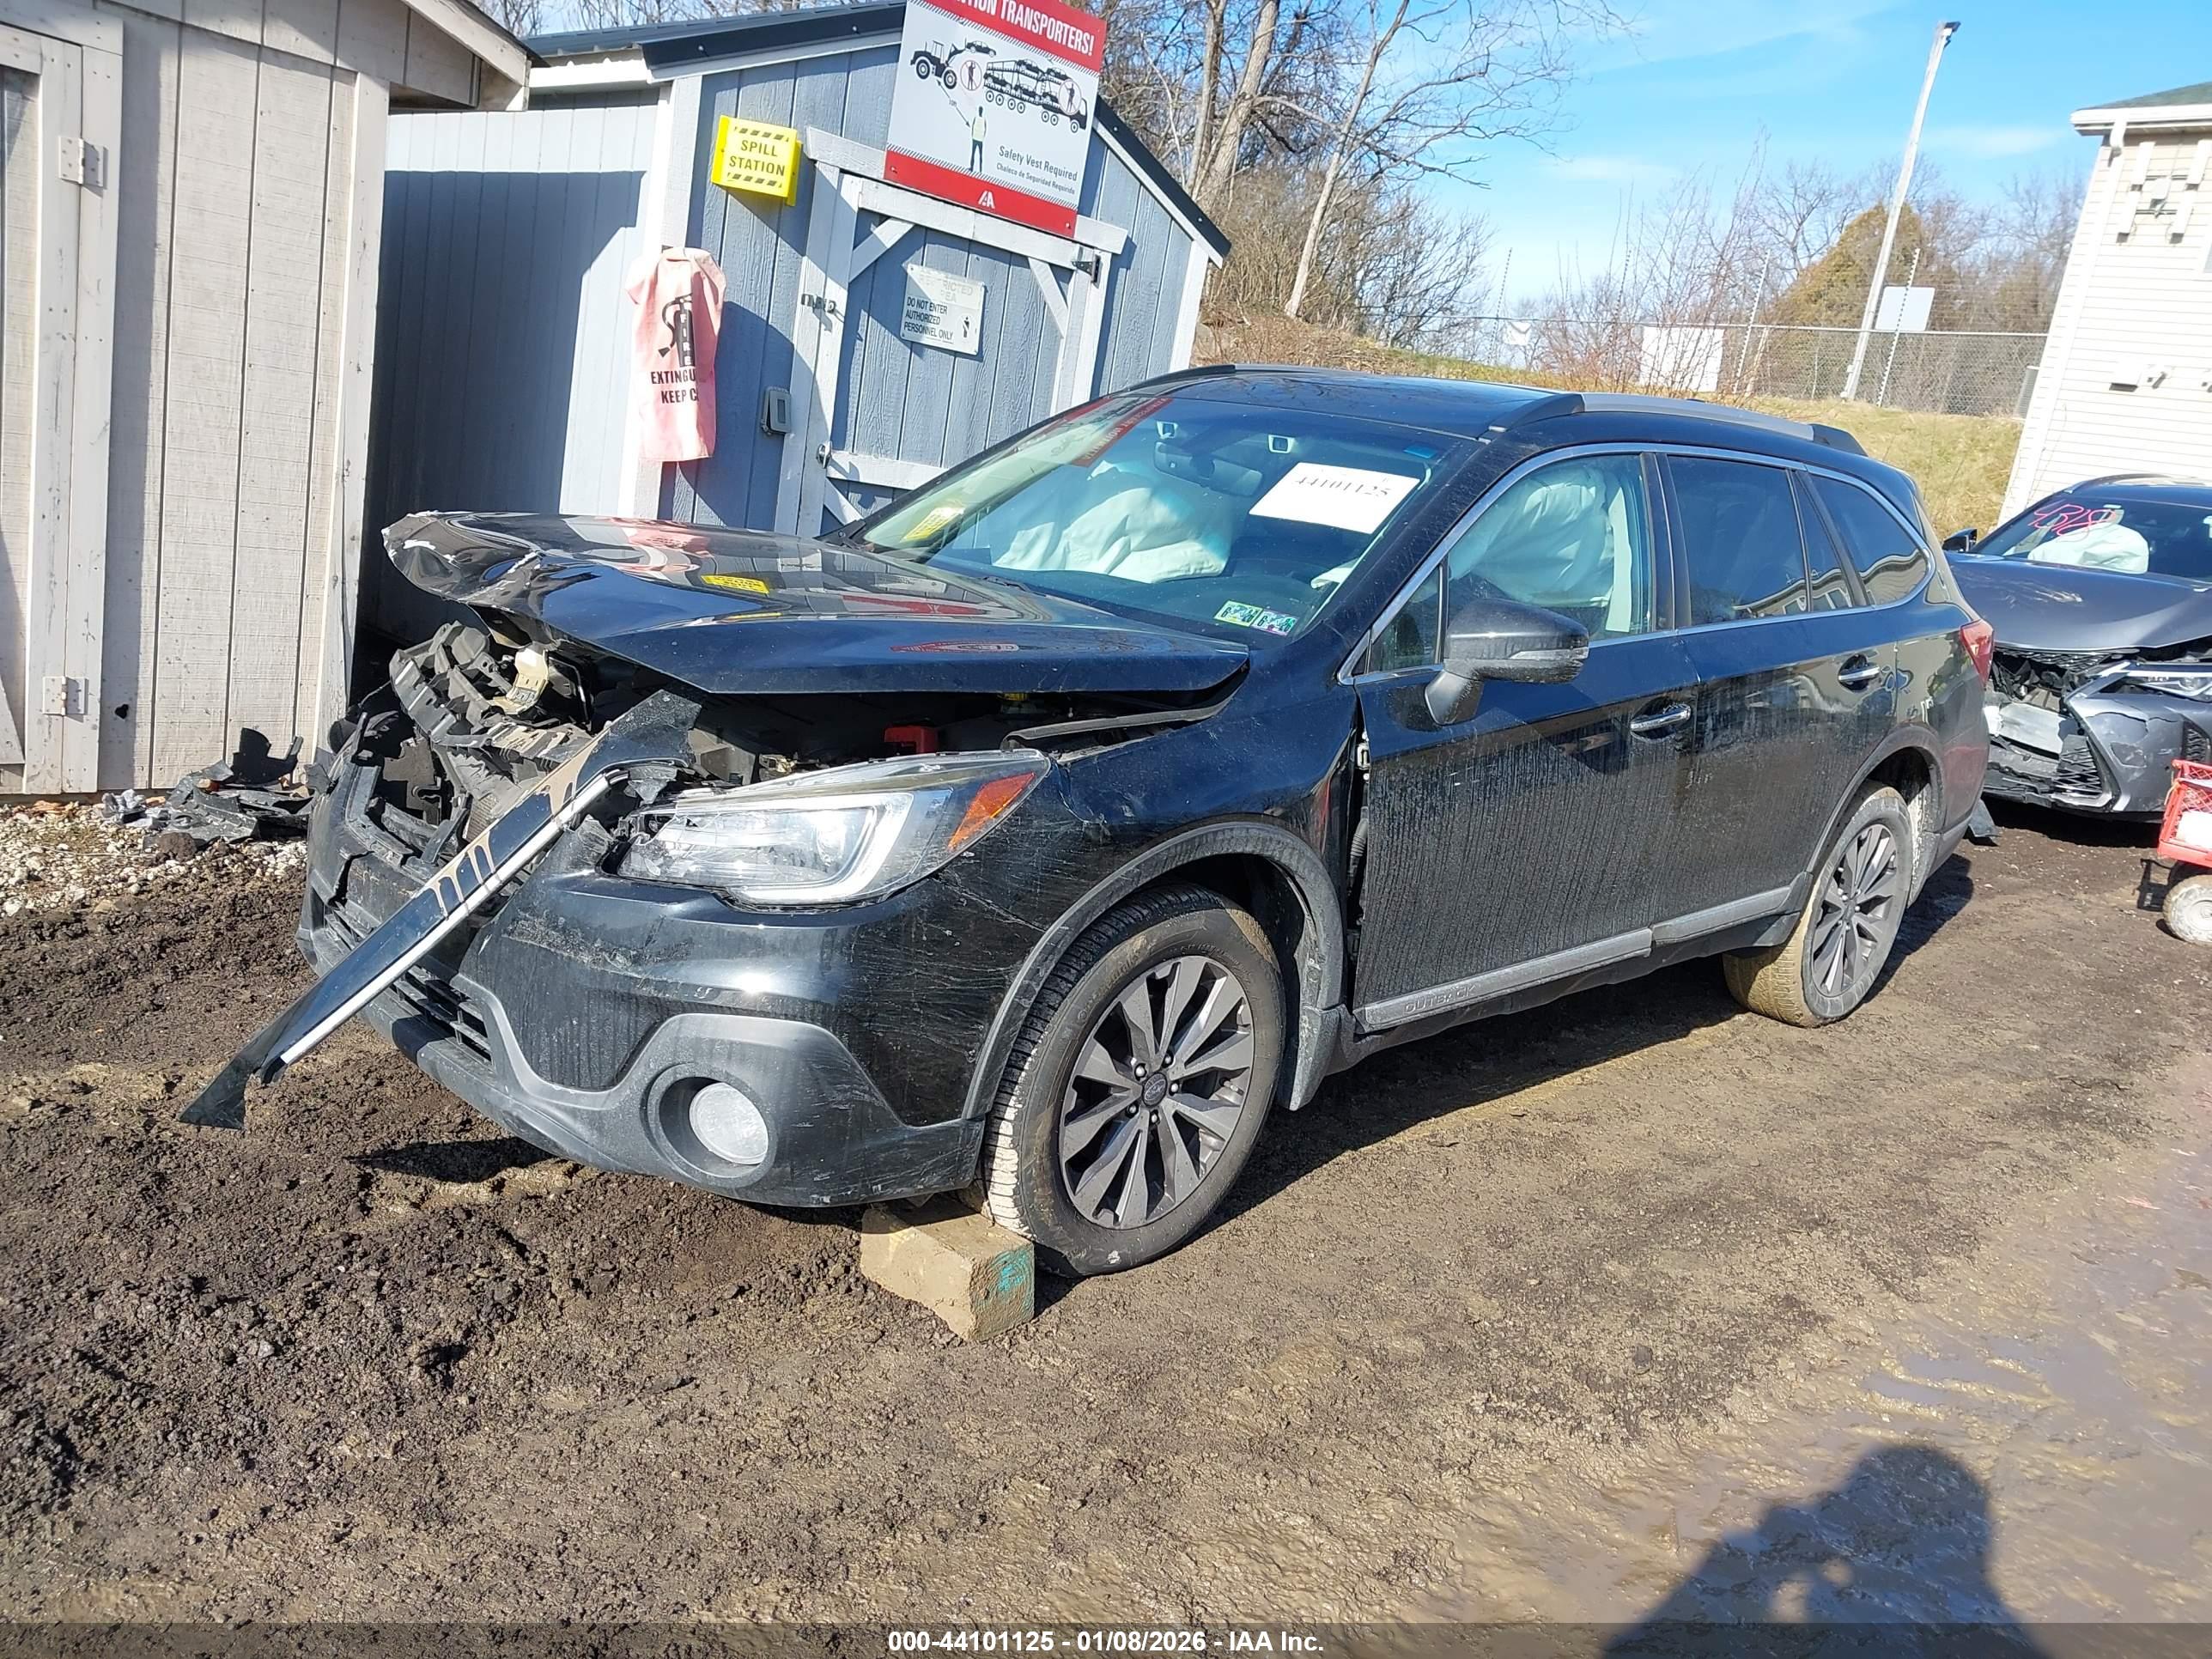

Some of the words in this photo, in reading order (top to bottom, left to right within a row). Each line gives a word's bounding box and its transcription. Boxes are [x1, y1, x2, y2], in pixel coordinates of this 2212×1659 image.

[1000, 0, 1095, 56] TRANSPORTERS!
[741, 139, 778, 157] SPILL
[729, 155, 786, 177] STATION
[999, 145, 1024, 165] Safety
[1026, 154, 1042, 169] Vest
[1043, 161, 1079, 181] Required
[907, 296, 916, 307] DO
[916, 299, 929, 310] NOT
[929, 301, 948, 315] ENTER
[905, 309, 941, 325] AUTHORIZED
[680, 313, 691, 367] FIRE
[904, 321, 938, 337] PERSONNEL
[939, 329, 954, 340] ONLY
[660, 390, 687, 404] KEEP
